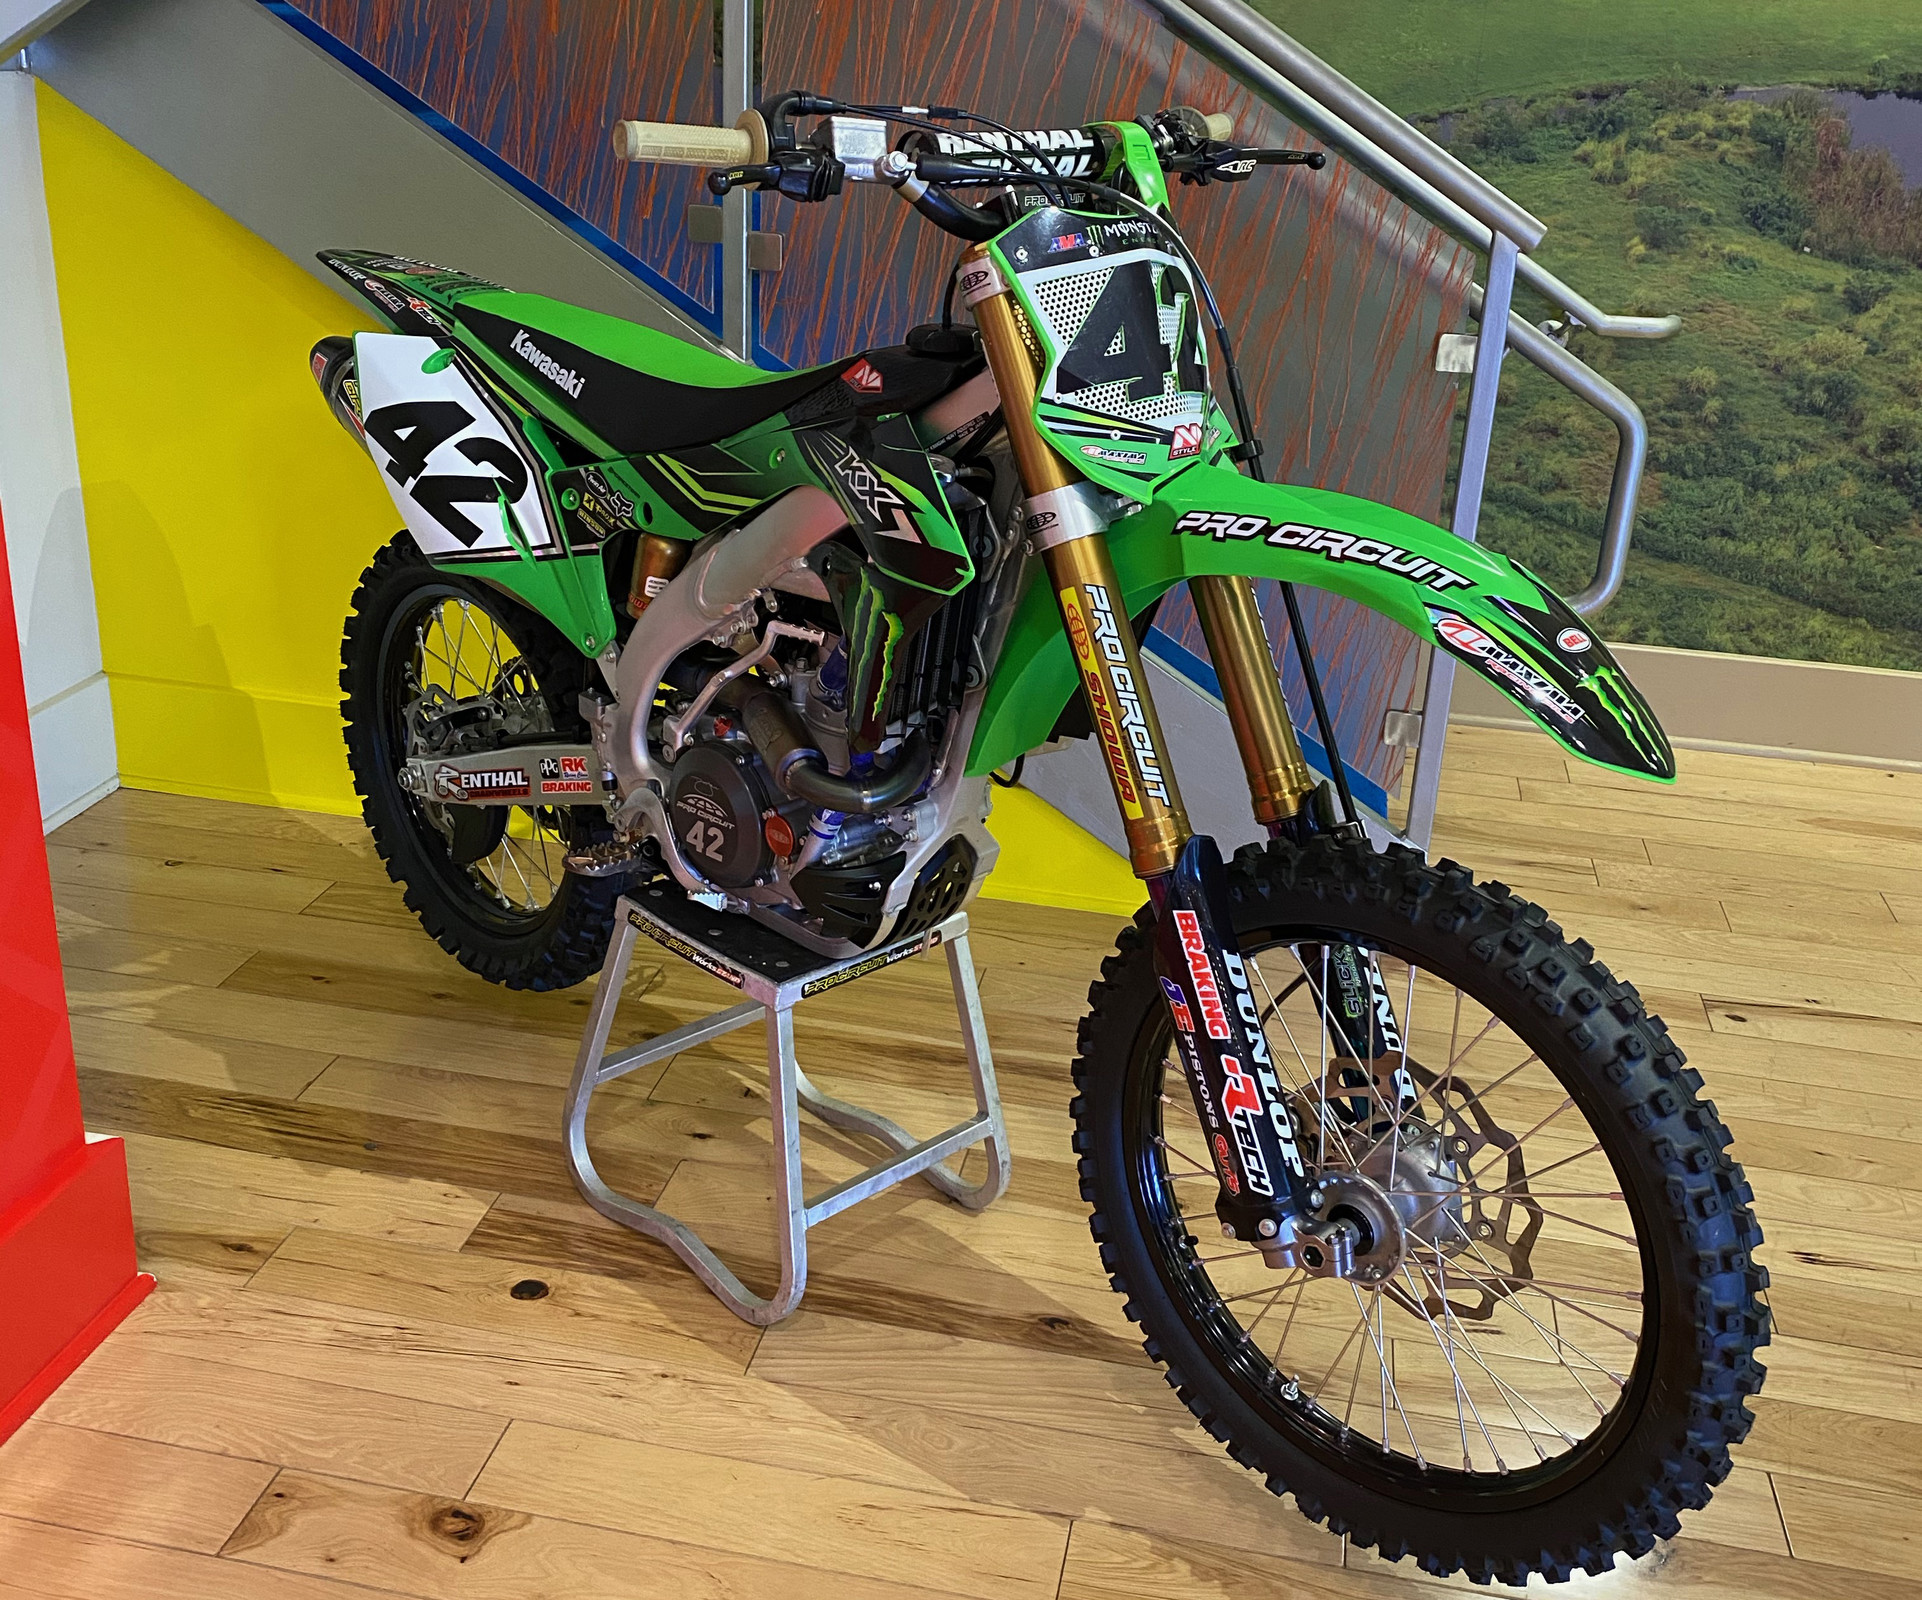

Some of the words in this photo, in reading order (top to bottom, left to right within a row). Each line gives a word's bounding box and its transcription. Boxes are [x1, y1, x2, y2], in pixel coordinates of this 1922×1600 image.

[1217, 160, 1257, 173] ARC
[1047, 232, 1086, 253] AMA
[1056, 259, 1207, 403] 42
[510, 328, 586, 399] Kawasaki
[364, 400, 529, 549] 42
[1097, 450, 1146, 459] MAXIMA
[1172, 446, 1197, 456] STYLE
[1175, 512, 1269, 540] PRO
[1266, 522, 1471, 591] CIRCUIT
[1562, 634, 1588, 648] BELL
[1084, 584, 1127, 663] PRO
[1109, 665, 1172, 807] CIRCUIT
[1084, 669, 1137, 803] SHOWA
[540, 758, 559, 776] PPG
[561, 757, 587, 771] RK
[542, 782, 592, 792] BRAKING
[677, 801, 696, 813] PRO
[697, 810, 736, 830] CIRCUIT
[685, 820, 724, 862] 42
[629, 913, 654, 931] PRO
[692, 953, 716, 972] Works
[804, 976, 839, 995] PRO
[836, 954, 890, 982] CIRCUIT
[886, 948, 914, 963] Works
[1176, 912, 1229, 1038] BRAKING
[1160, 976, 1195, 1033] JE
[1183, 1033, 1219, 1129] PISTONS
[1222, 949, 1305, 1177] DUNLOP
[1214, 1133, 1240, 1194] GUTS
